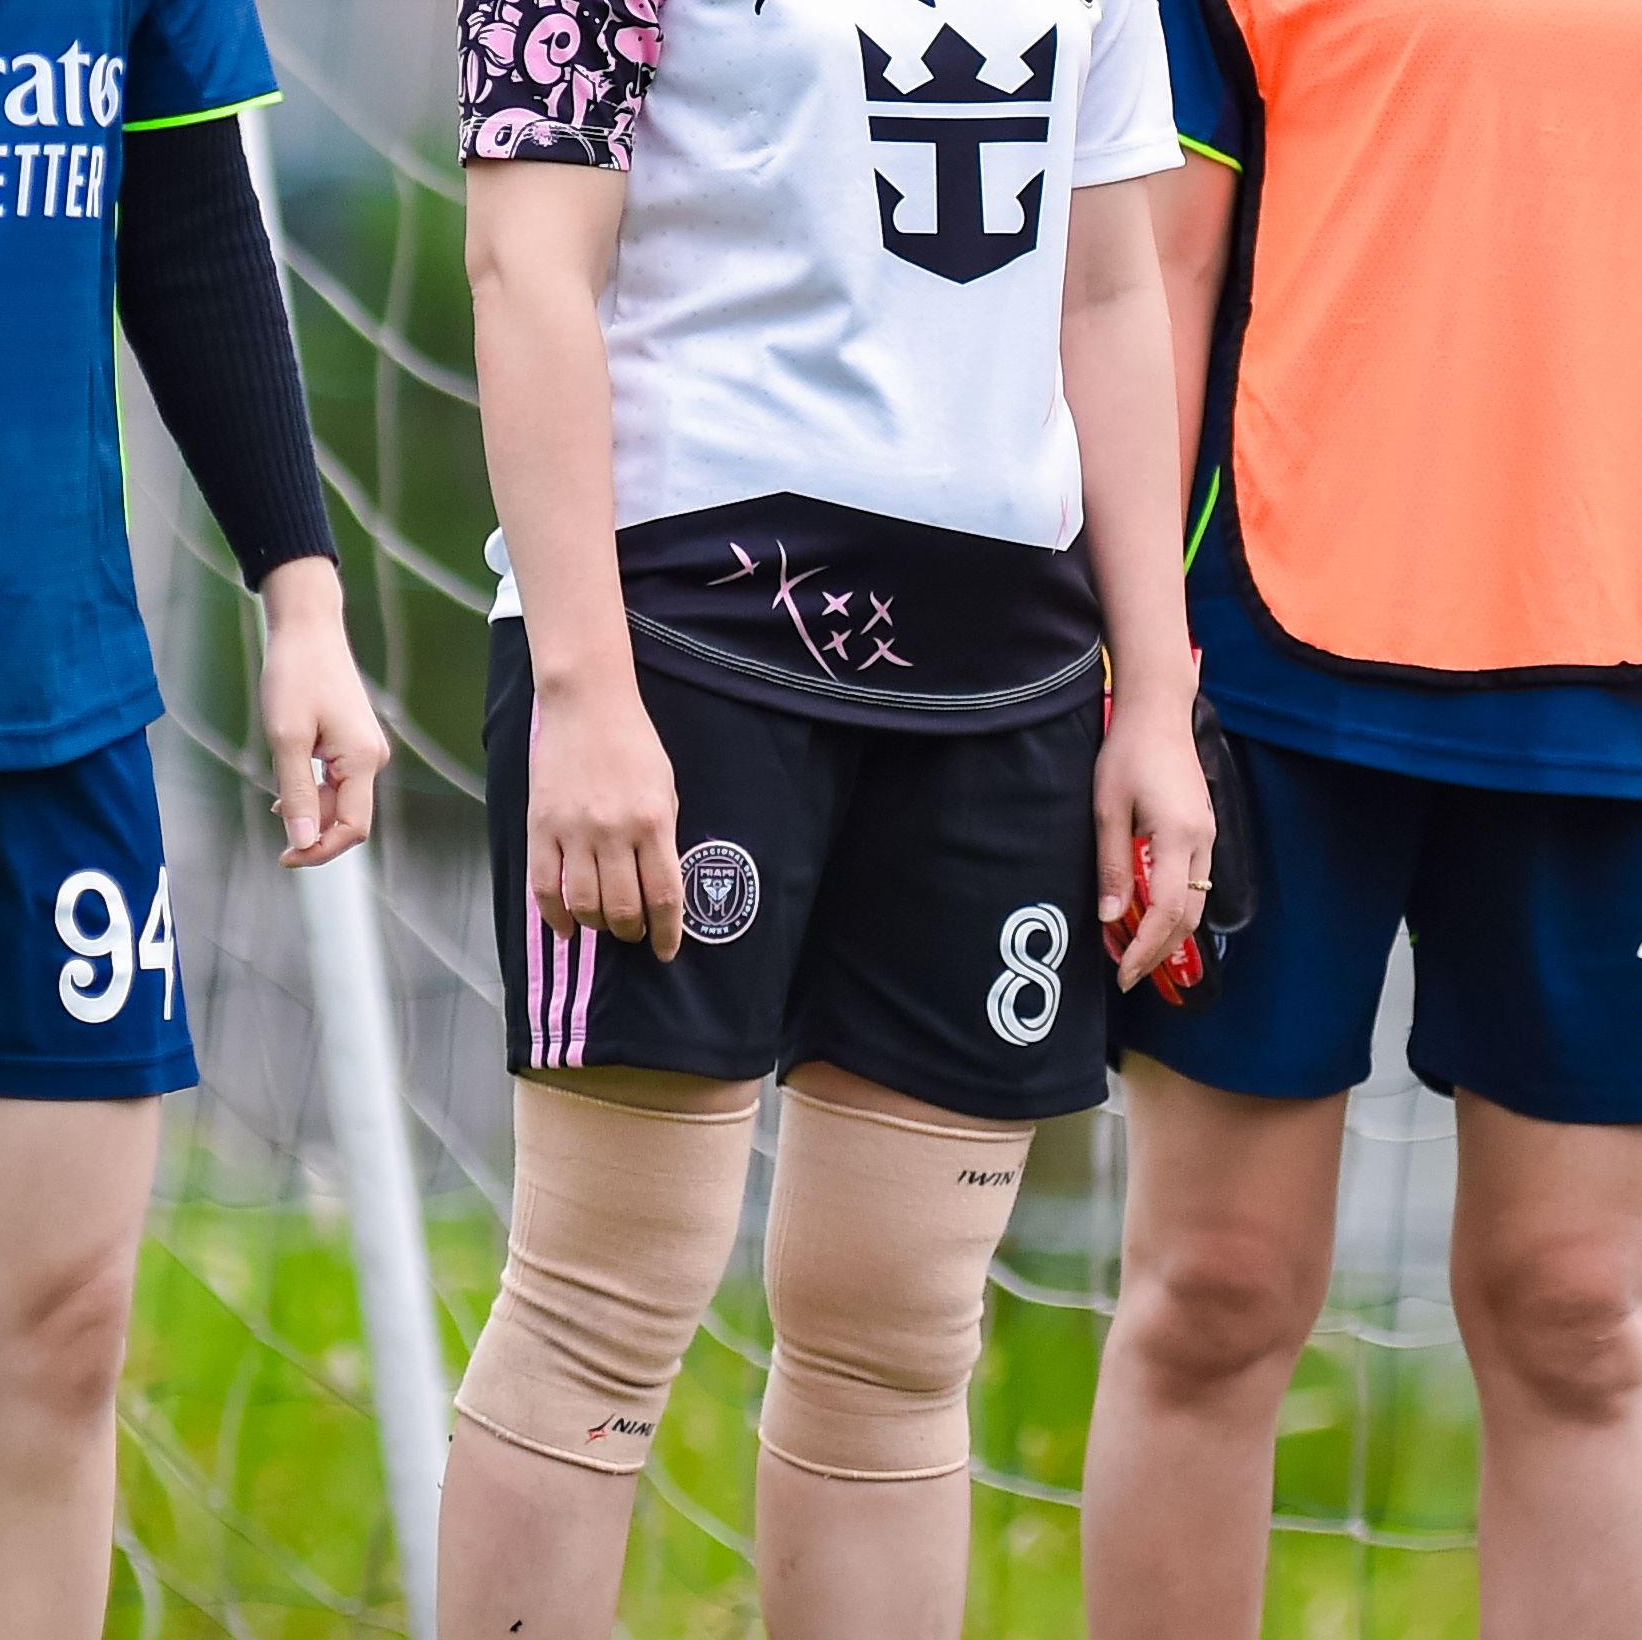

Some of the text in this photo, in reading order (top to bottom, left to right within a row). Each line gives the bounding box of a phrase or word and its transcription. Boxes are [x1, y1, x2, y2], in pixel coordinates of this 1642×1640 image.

[54, 865, 174, 1024] 94
[700, 868, 735, 877] MIAMI
[986, 902, 1069, 1047] 8
